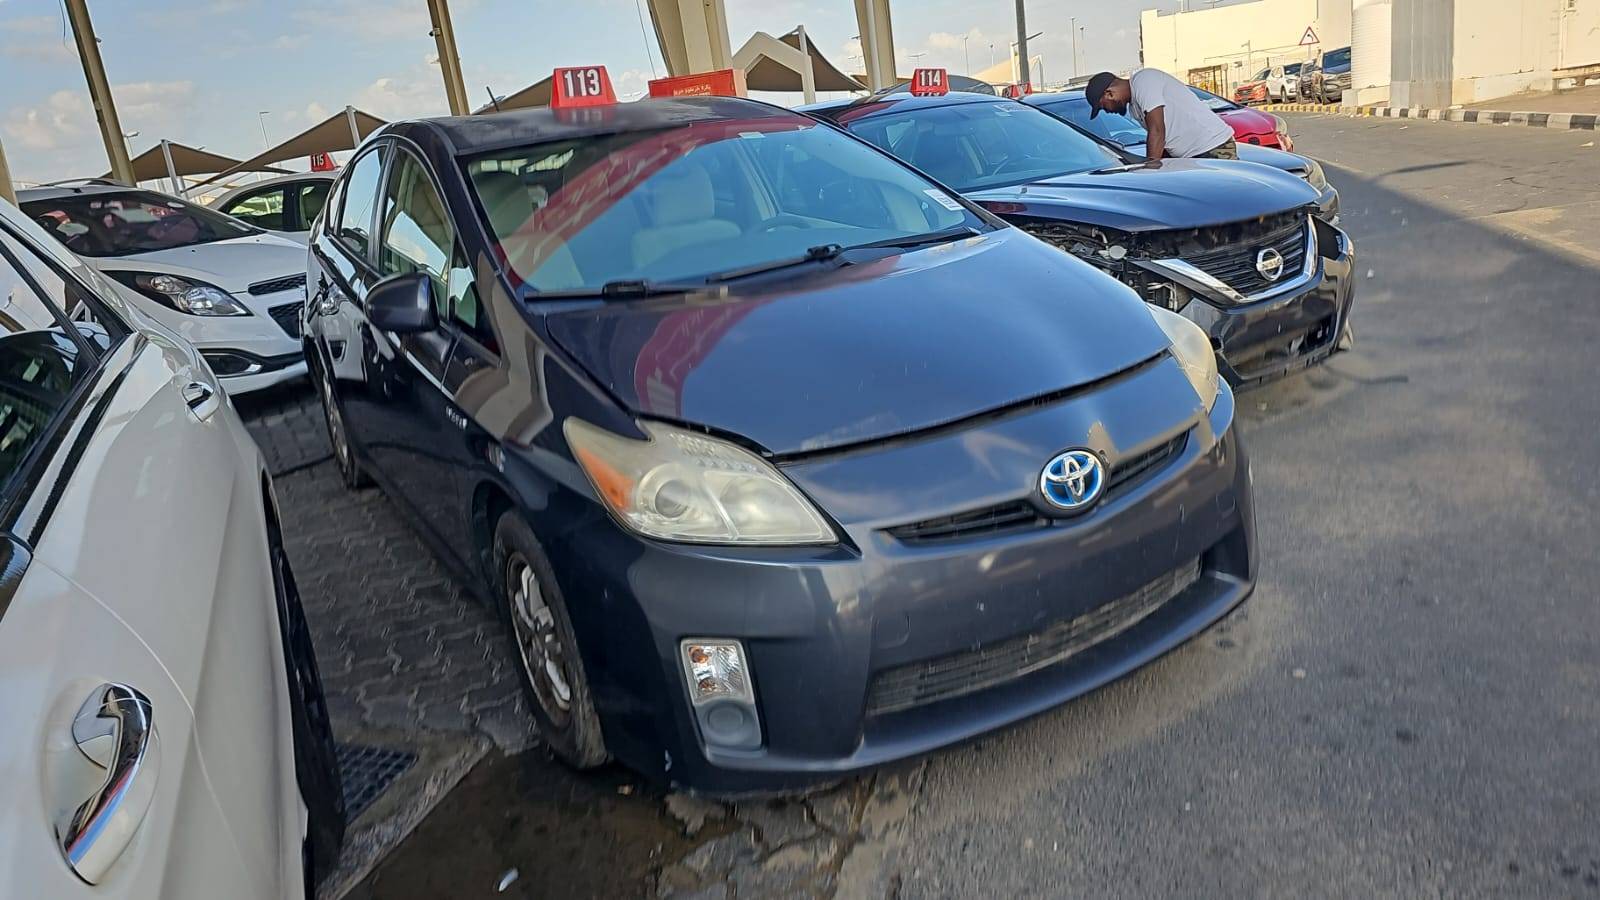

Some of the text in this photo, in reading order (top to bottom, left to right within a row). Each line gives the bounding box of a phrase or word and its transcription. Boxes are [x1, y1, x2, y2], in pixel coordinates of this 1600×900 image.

[564, 68, 600, 97] 113
[919, 70, 941, 87] 114
[312, 153, 325, 167] 115
